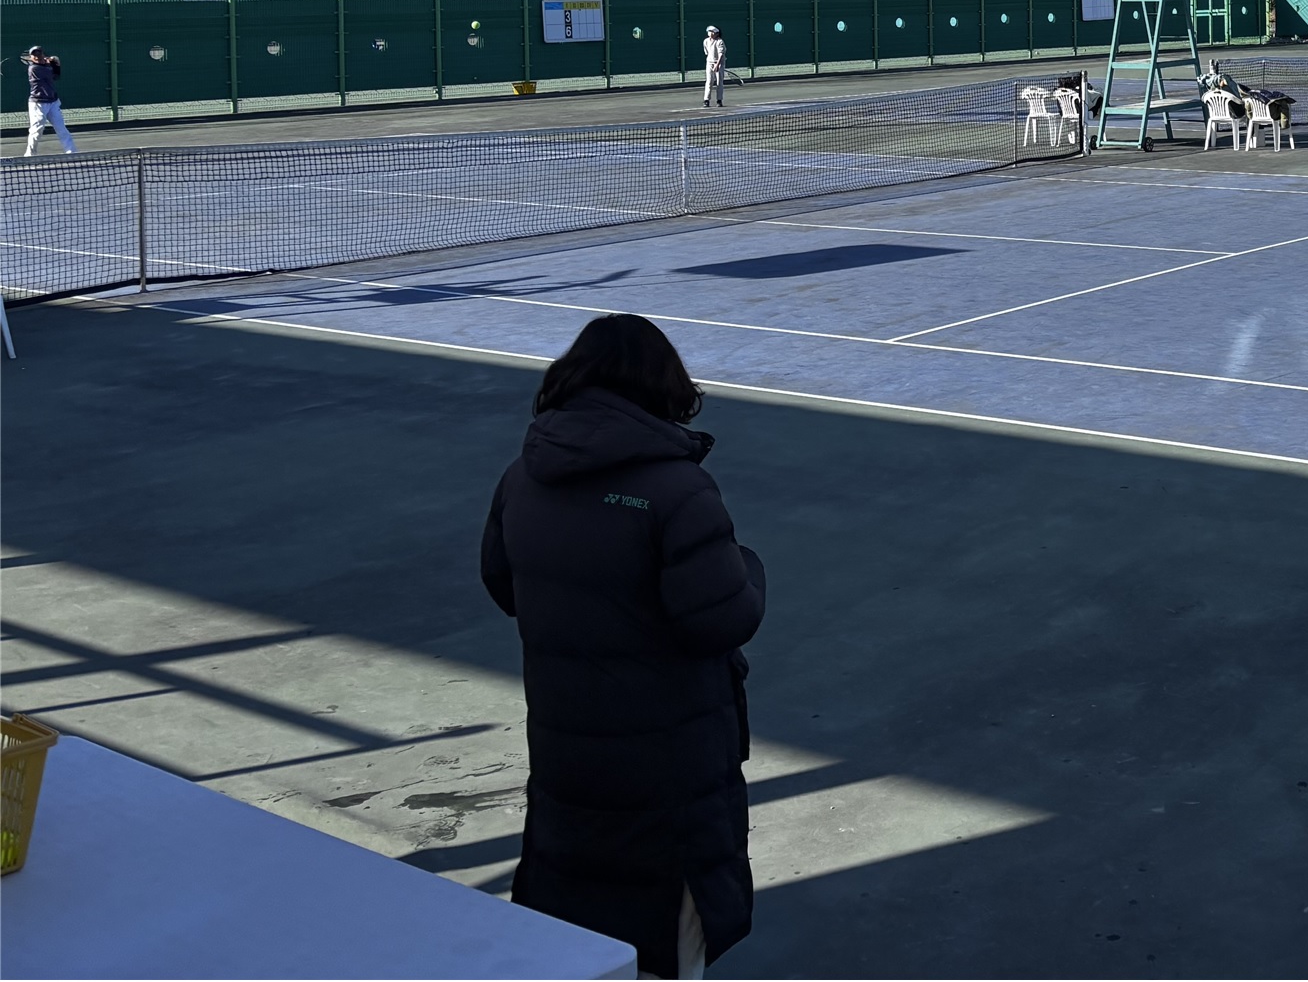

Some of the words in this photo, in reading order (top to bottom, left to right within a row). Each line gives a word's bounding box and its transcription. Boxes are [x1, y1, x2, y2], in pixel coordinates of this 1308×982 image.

[565, 11, 571, 23] 3
[566, 26, 572, 37] 6
[621, 495, 650, 510] YONEX
